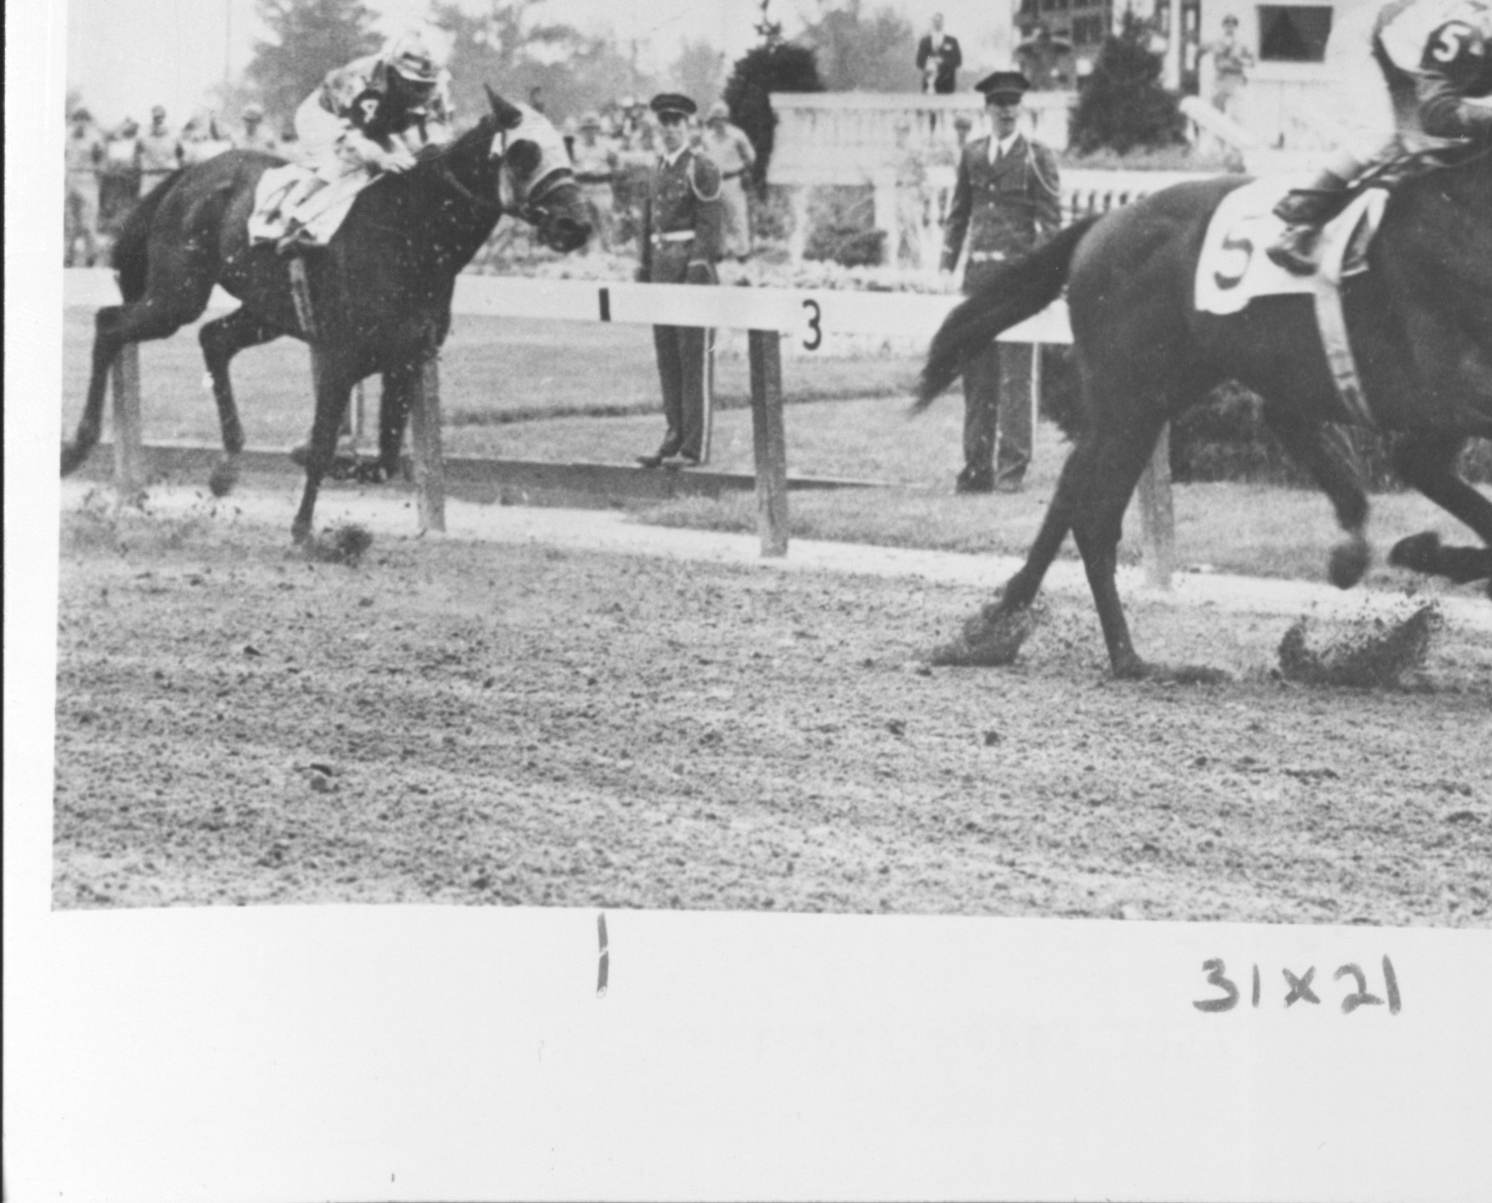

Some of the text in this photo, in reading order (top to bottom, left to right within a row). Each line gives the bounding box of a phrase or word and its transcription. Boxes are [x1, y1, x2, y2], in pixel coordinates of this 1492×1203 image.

[1432, 23, 1473, 63] 5
[1213, 215, 1262, 291] 5
[801, 298, 822, 352] 3
